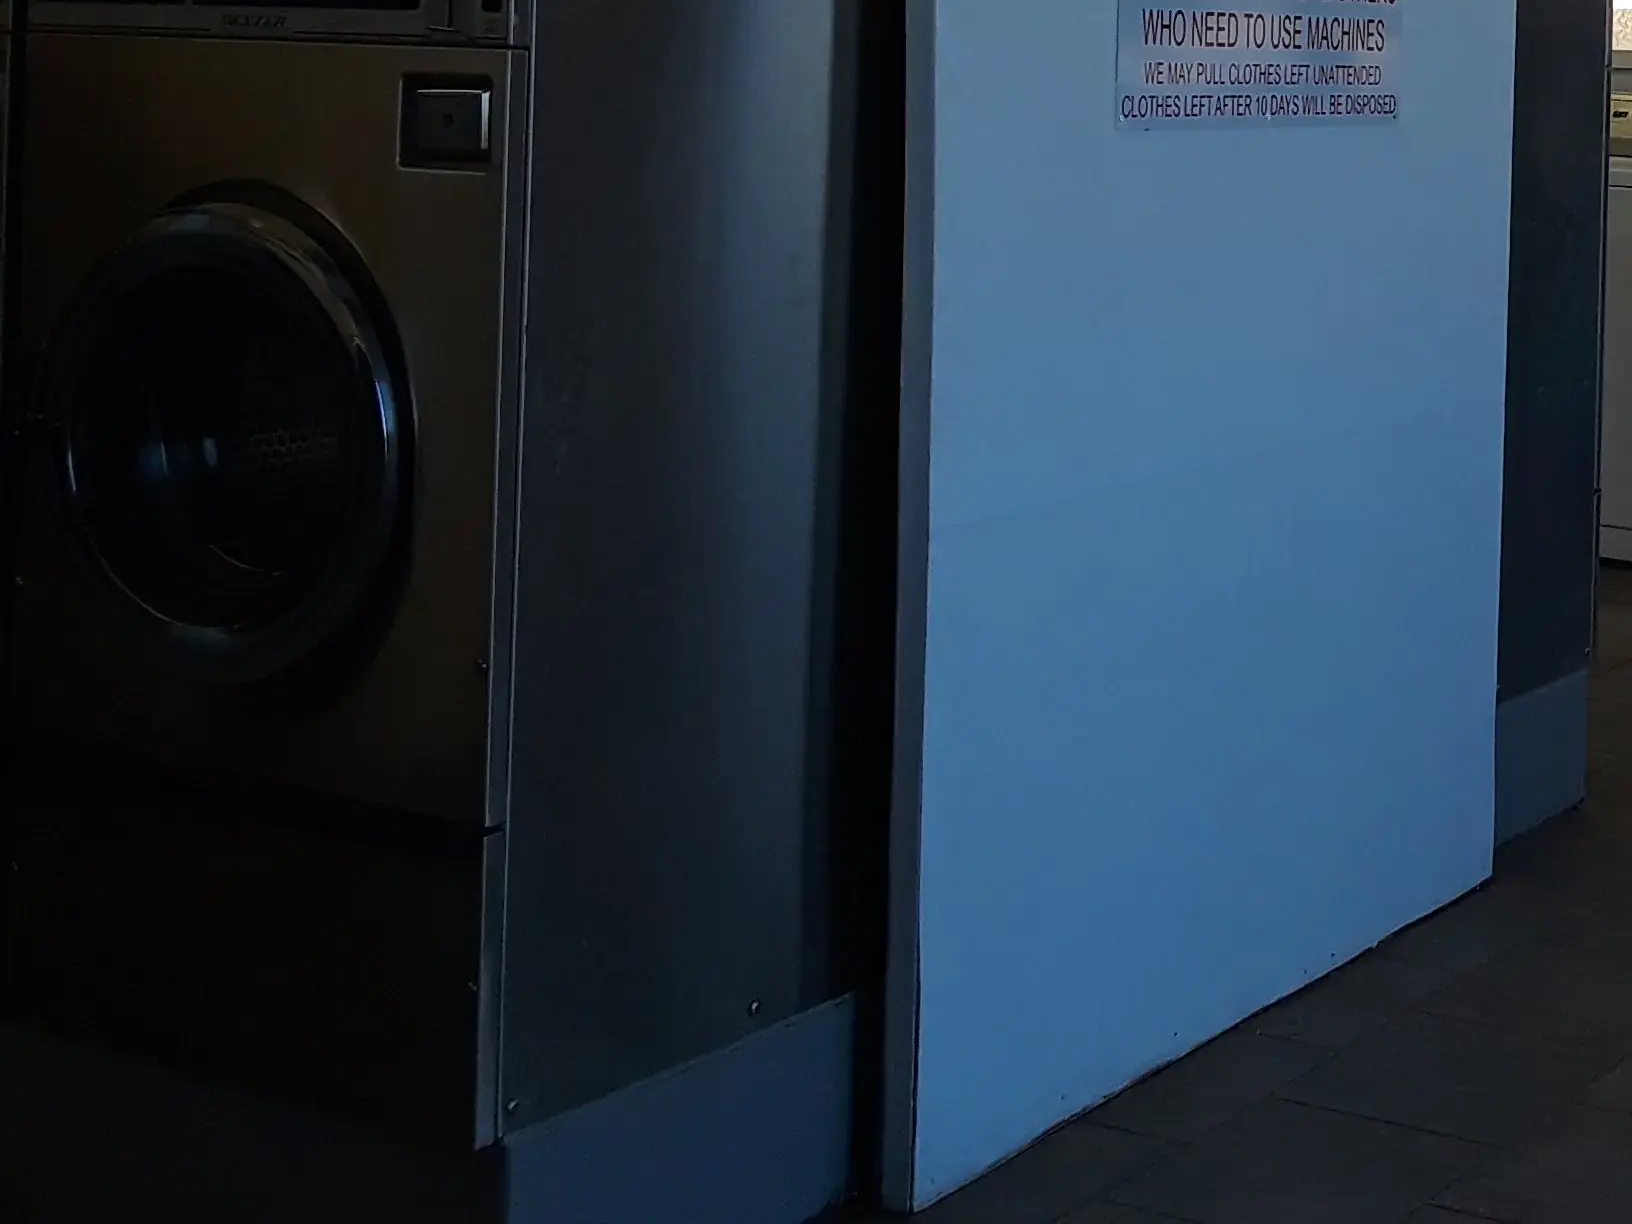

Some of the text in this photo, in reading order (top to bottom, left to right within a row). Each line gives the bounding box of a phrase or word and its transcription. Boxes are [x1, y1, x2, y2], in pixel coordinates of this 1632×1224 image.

[1142, 8, 1385, 52] WHO NEED TO USE MACHINES
[1144, 62, 1382, 87] WE MAY PULL CLOTHES LEFT UNATTENDED
[1121, 94, 1397, 119] CLOTHES LEFT AFTER 10 DAYS WILL BE DISPOSED
